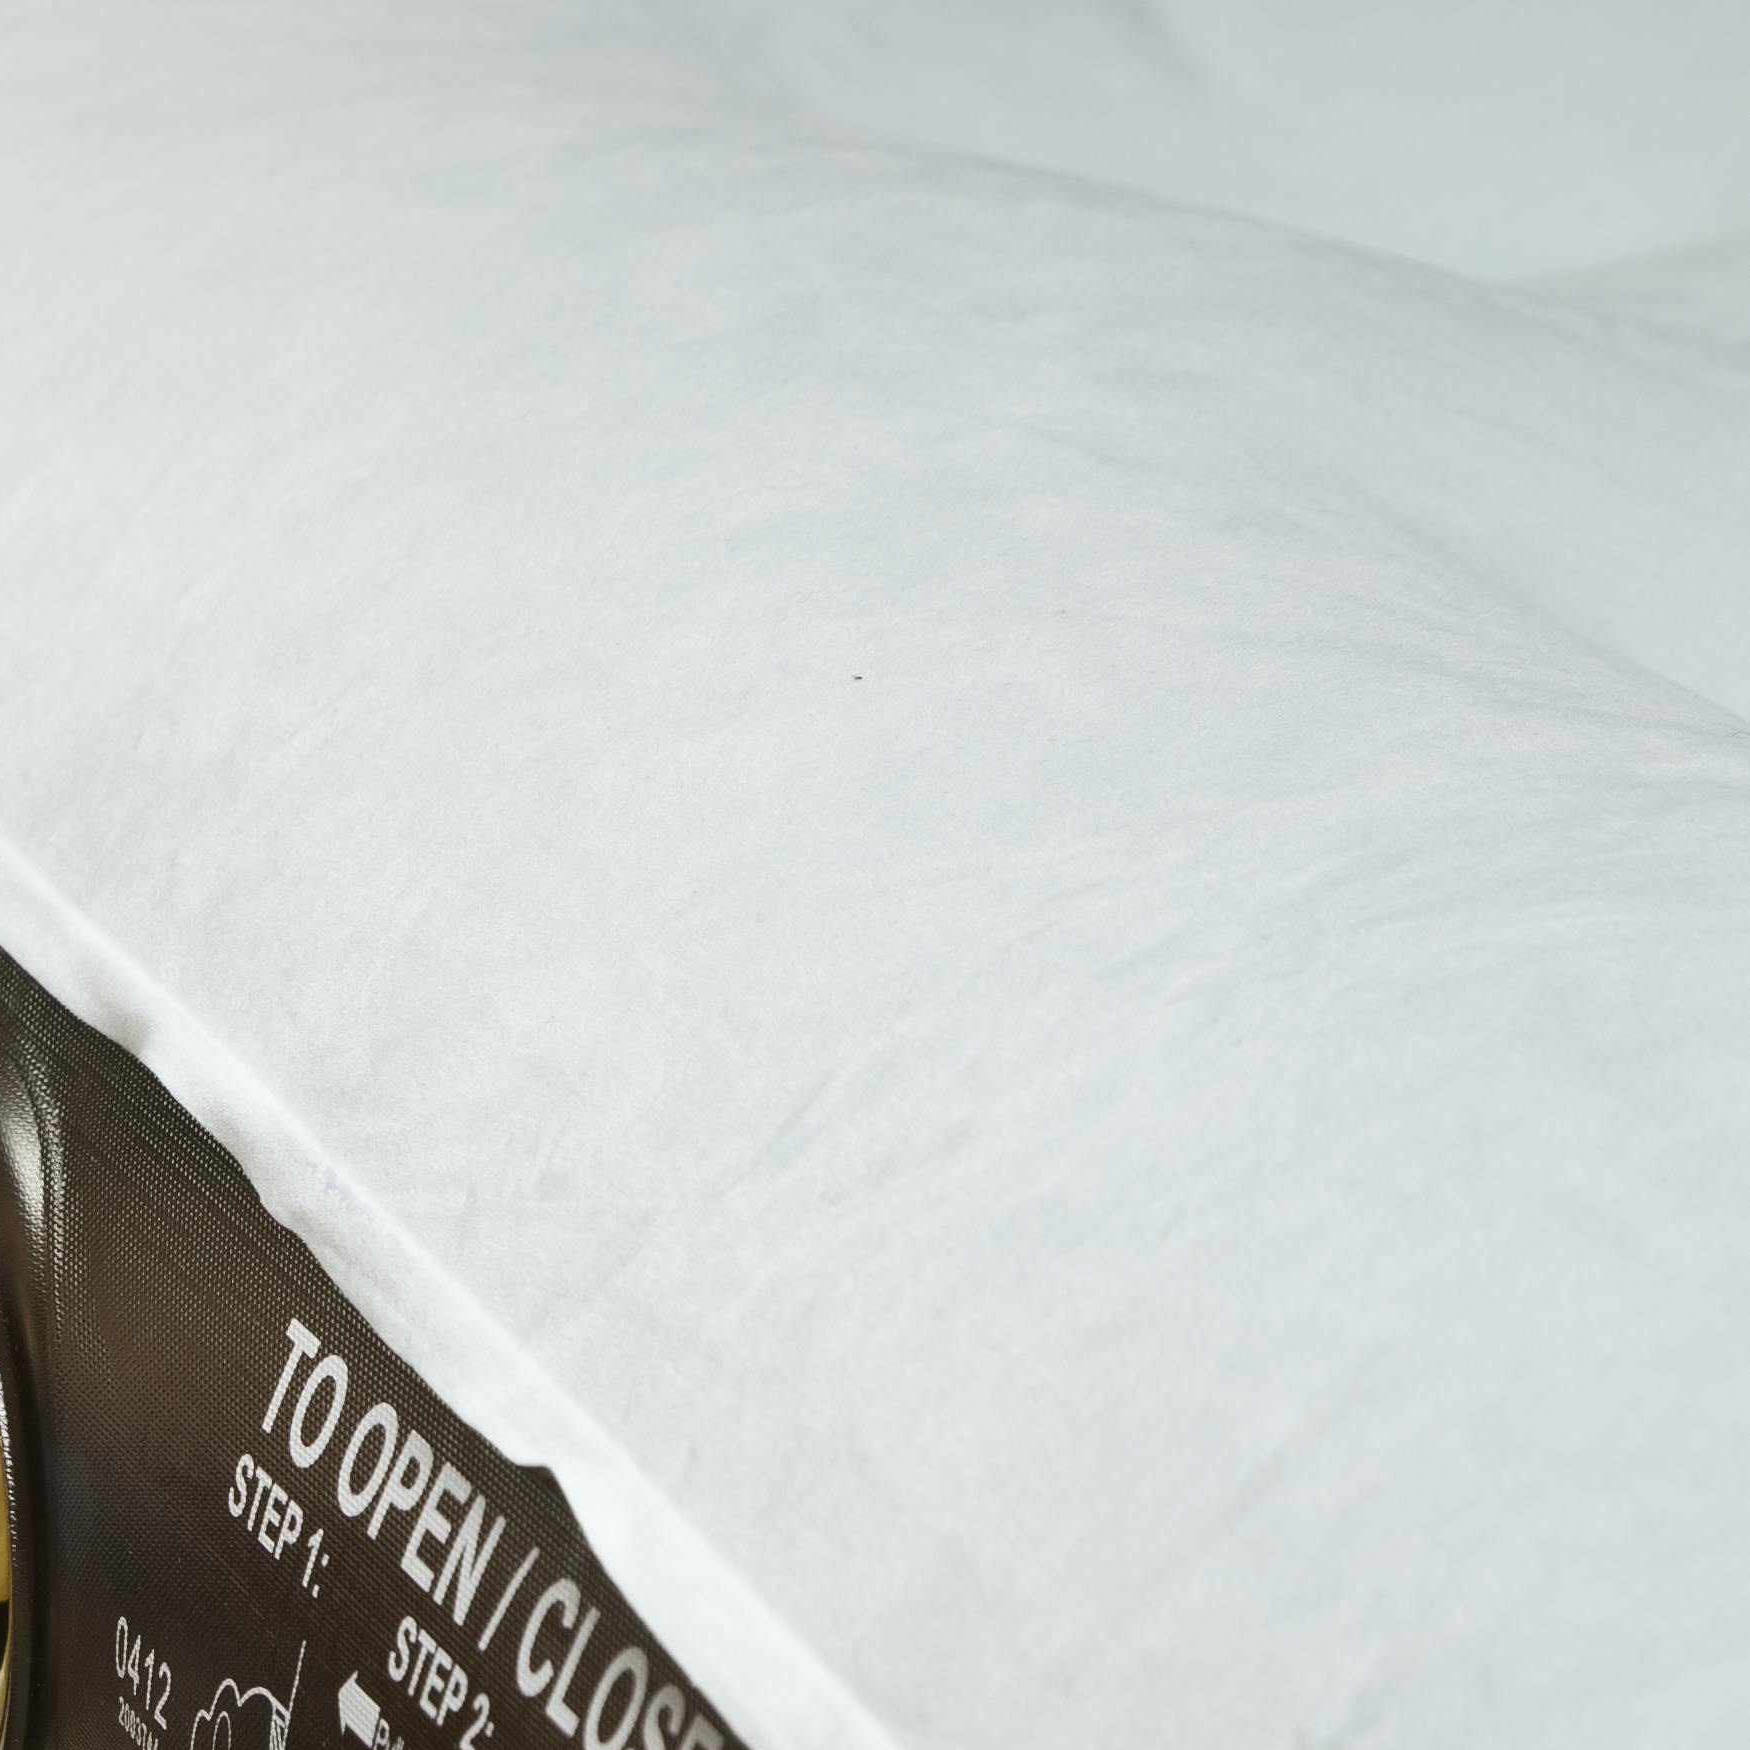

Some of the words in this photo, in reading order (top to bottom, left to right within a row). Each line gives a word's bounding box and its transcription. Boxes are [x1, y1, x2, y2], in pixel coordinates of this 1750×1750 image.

[228, 1453, 304, 1561] STEP
[301, 1527, 330, 1599] 1:
[261, 1317, 348, 1470] TO
[336, 1401, 505, 1628] OPEN
[477, 1548, 539, 1651] /
[115, 1616, 172, 1730] 0412
[387, 1615, 469, 1728] STEP
